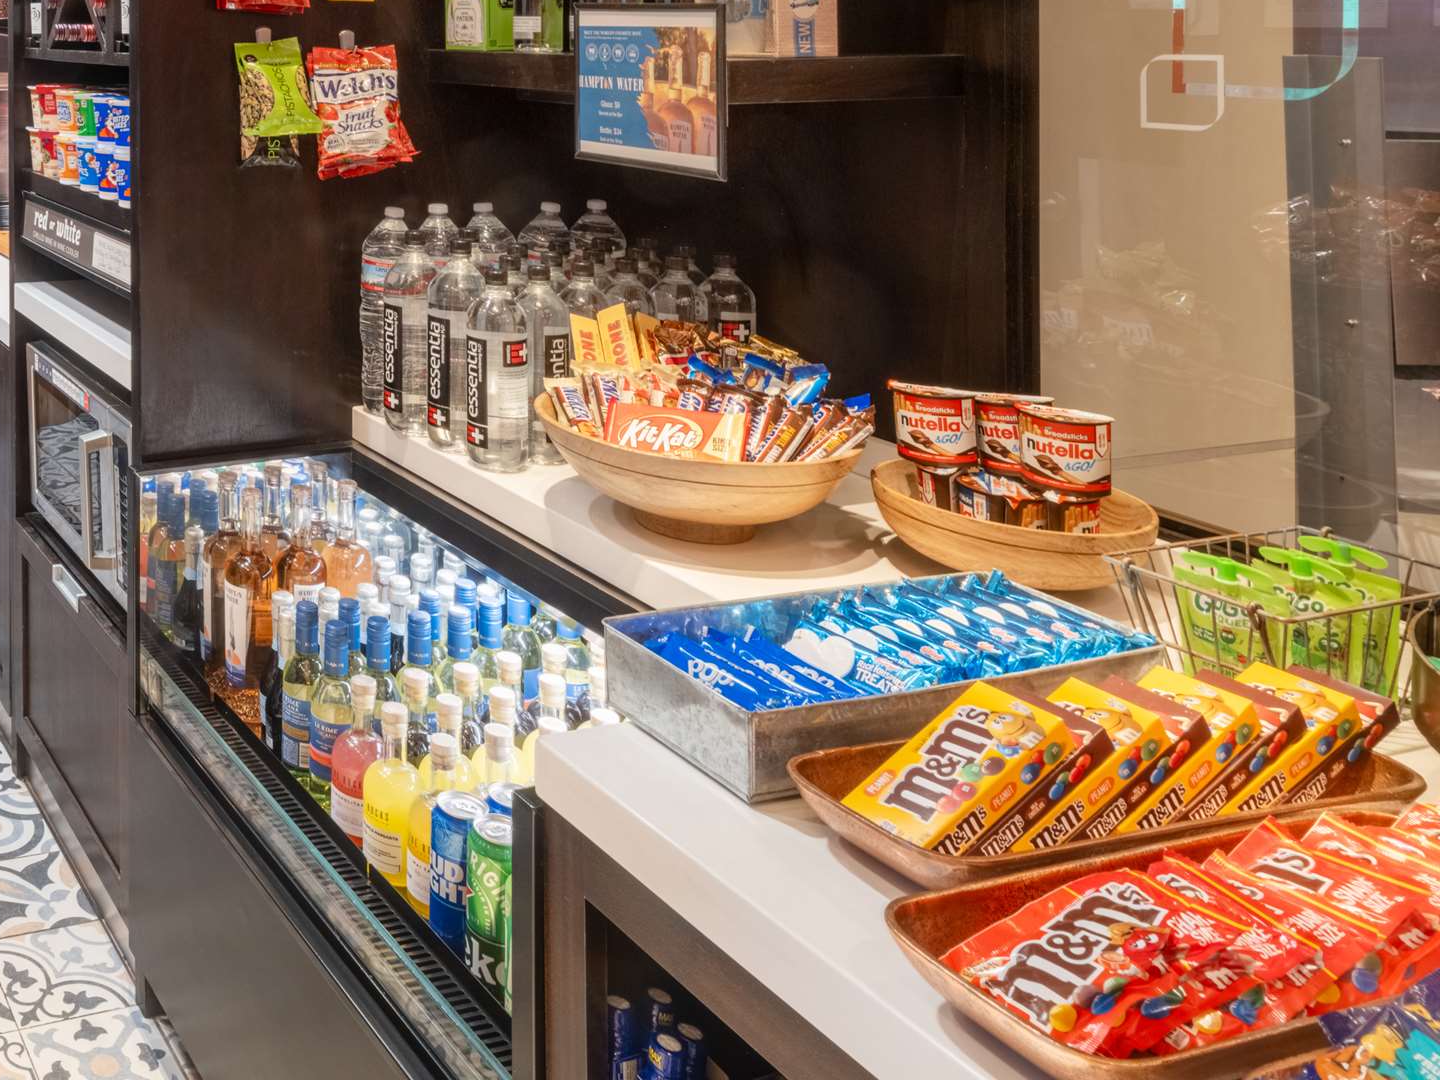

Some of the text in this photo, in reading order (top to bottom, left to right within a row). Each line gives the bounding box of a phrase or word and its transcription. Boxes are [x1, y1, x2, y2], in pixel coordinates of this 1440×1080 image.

[798, 23, 811, 53] NEW
[318, 72, 396, 99] Welch's
[616, 77, 644, 92] WATER
[337, 119, 384, 134] Snacks
[345, 108, 376, 122] Fruit
[33, 210, 50, 231] red
[56, 219, 82, 246] white
[385, 307, 395, 383] essentia
[429, 320, 441, 399] essentia
[467, 340, 478, 418] essentia
[901, 415, 961, 433] nutella
[977, 422, 1019, 440] nutel
[1027, 437, 1095, 460] nutella
[855, 670, 902, 694] TREATS
[882, 707, 995, 823] m&m's
[1189, 764, 1210, 787] PEANUT
[866, 772, 894, 795] PEANUT
[1091, 779, 1112, 802] PEANUT
[993, 784, 1015, 808] PEANUT
[1137, 784, 1186, 829] m&m's
[431, 880, 467, 906] GHT
[987, 883, 1169, 1033] m&m's
